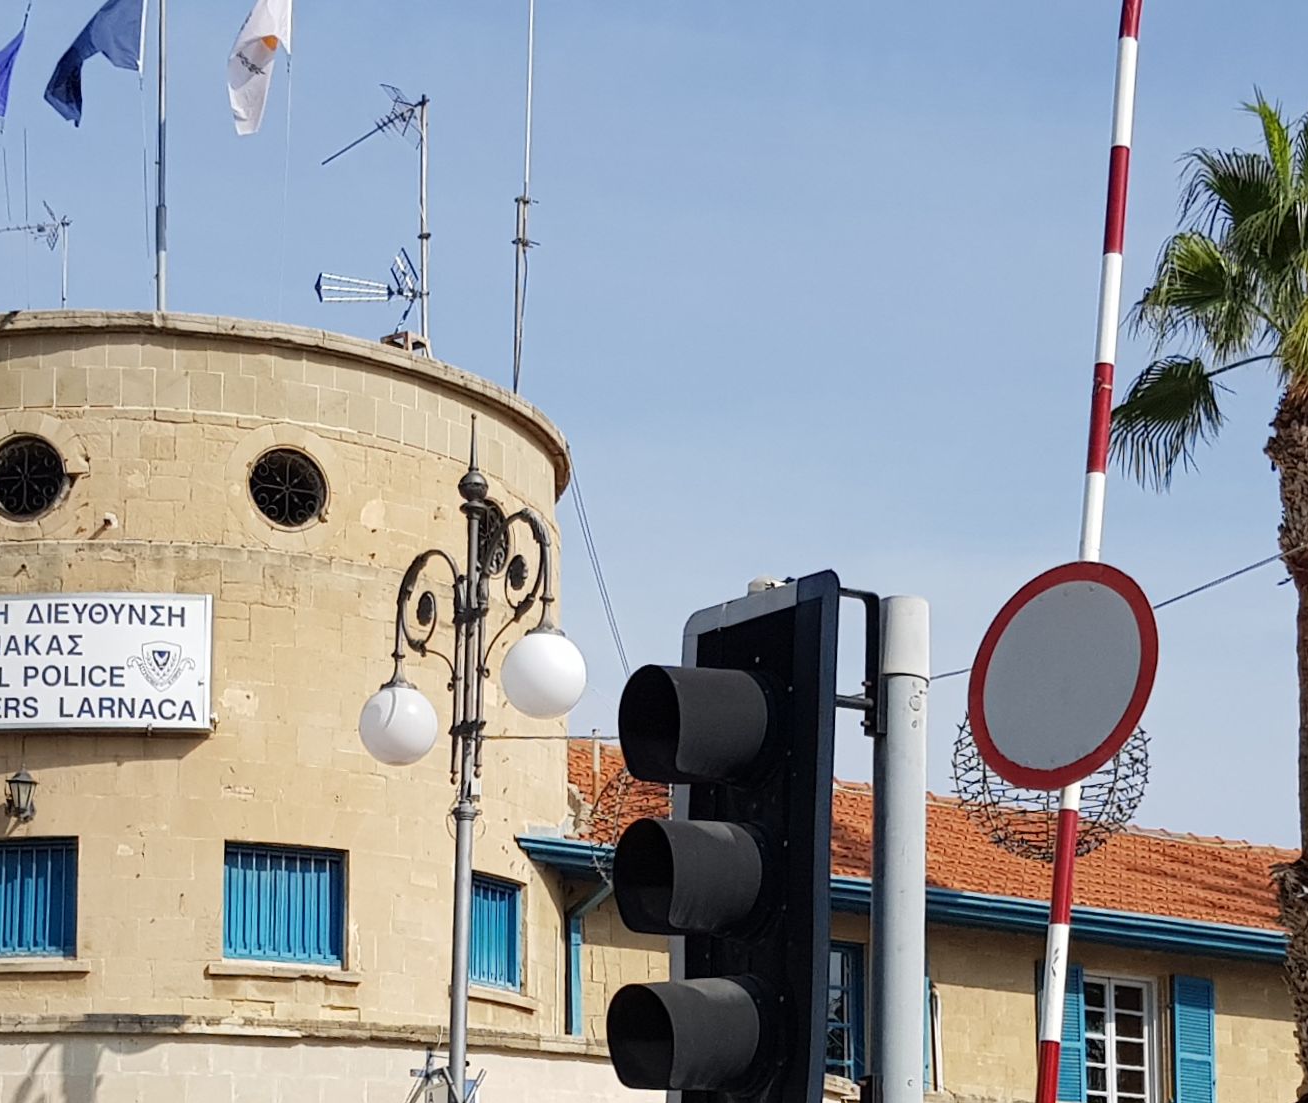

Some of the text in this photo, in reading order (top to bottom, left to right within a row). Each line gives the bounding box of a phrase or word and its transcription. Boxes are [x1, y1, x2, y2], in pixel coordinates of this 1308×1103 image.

[26, 603, 186, 627] ΔΙΕΥΘΥΝΣΗ
[23, 665, 125, 688] POLICE
[59, 697, 197, 722] LARNACA
